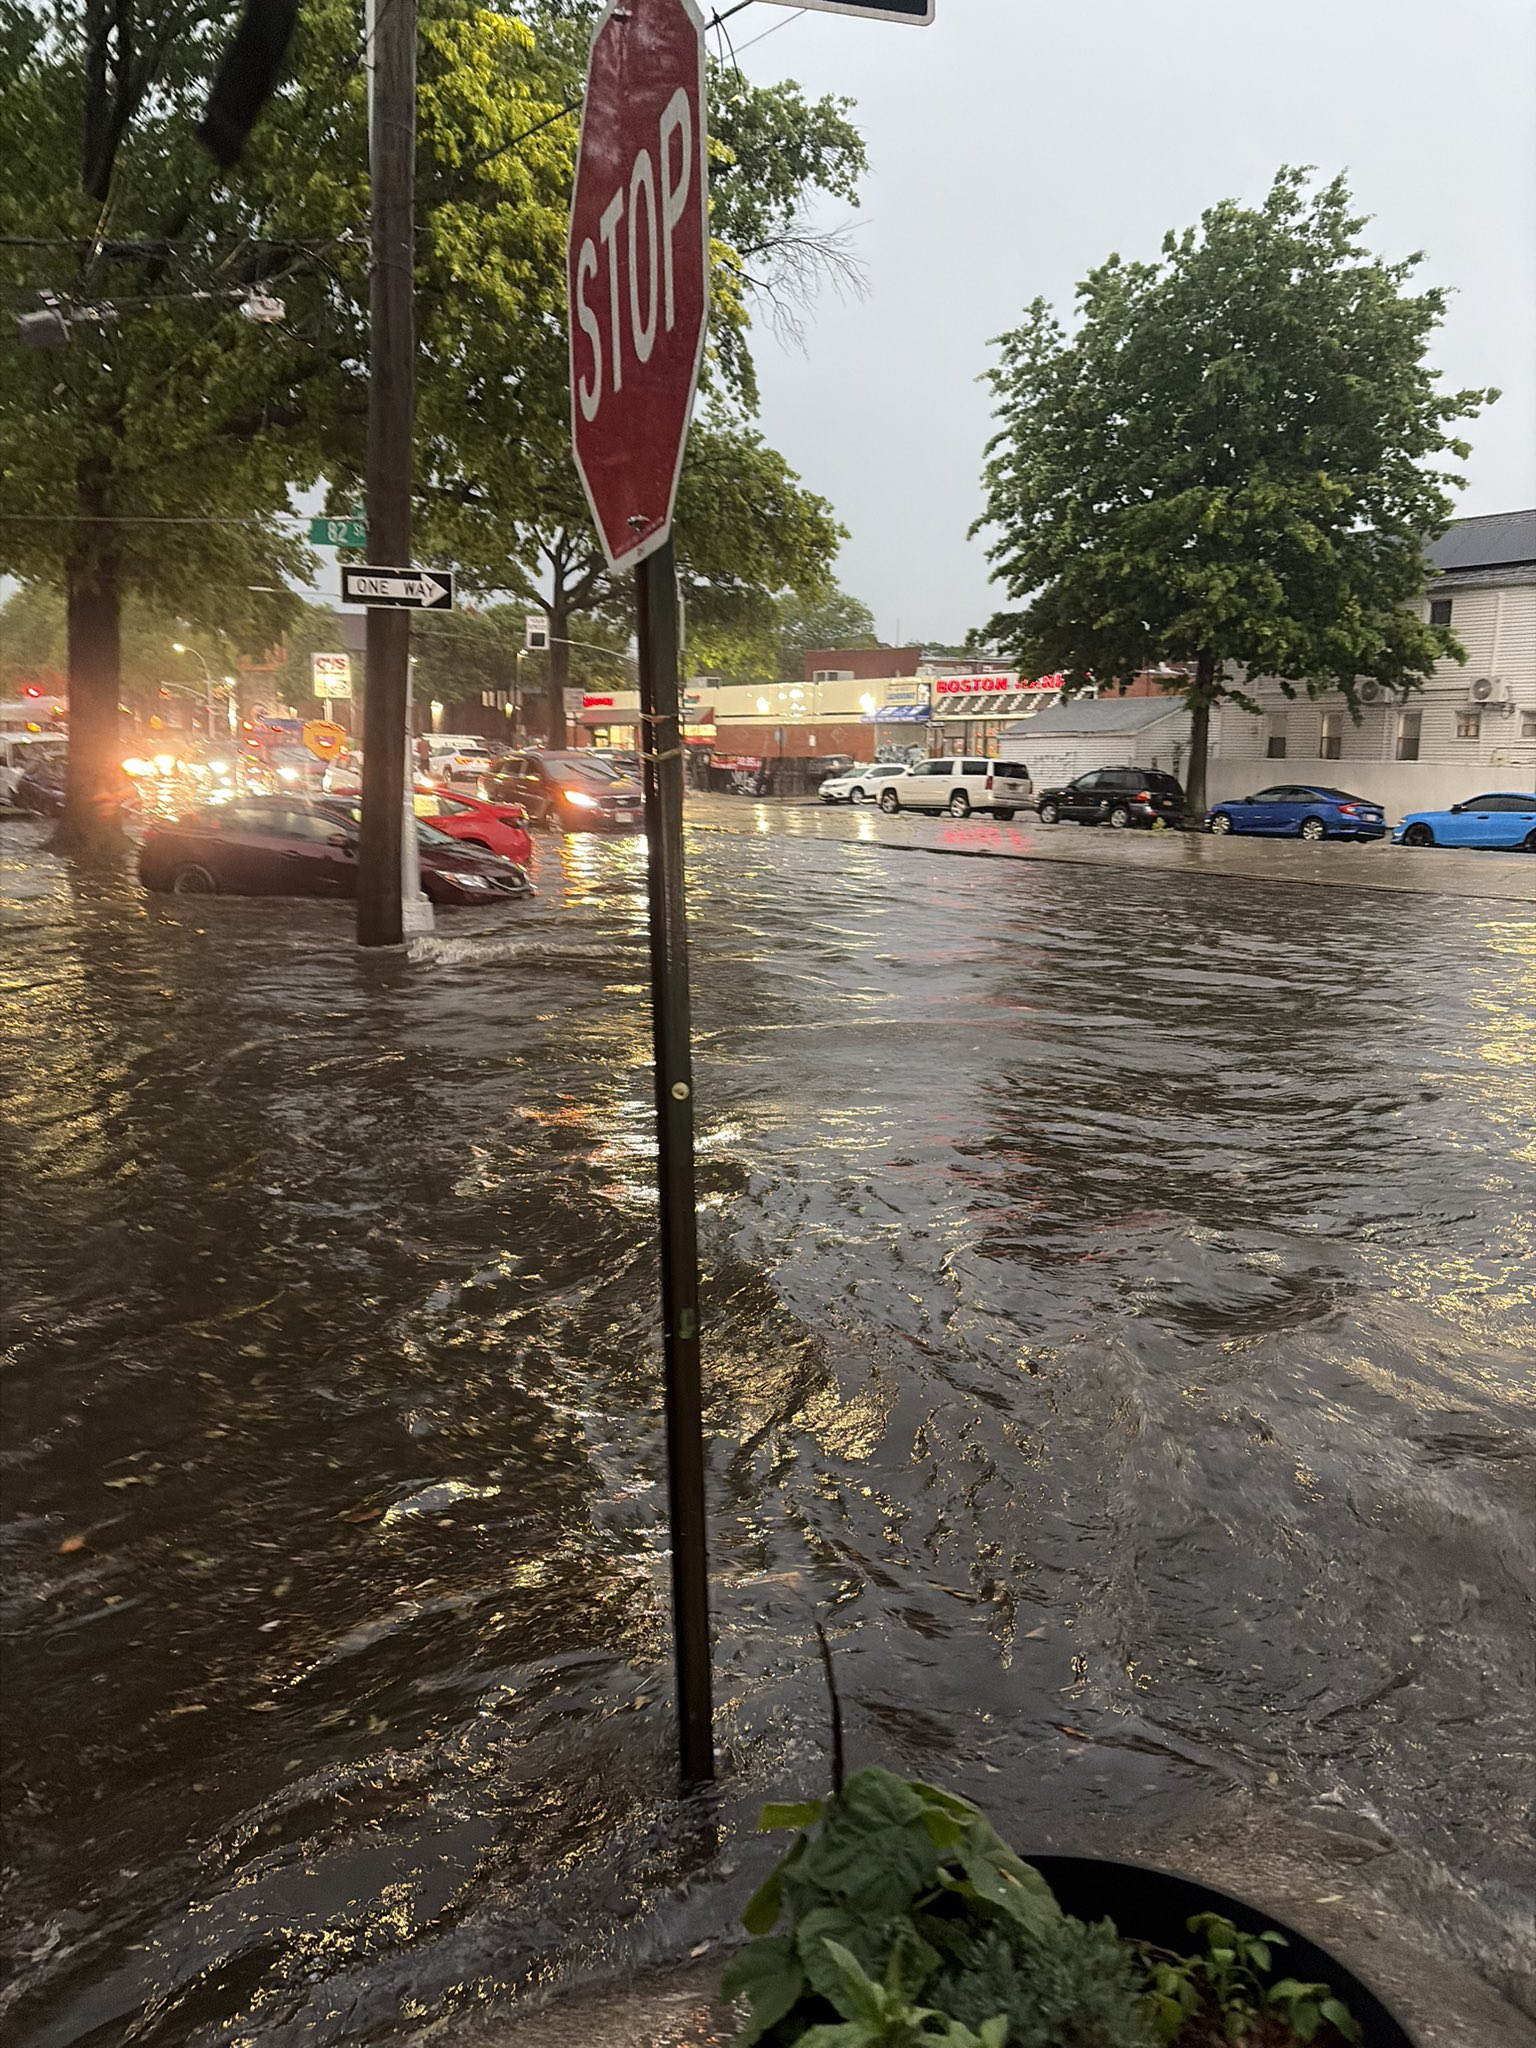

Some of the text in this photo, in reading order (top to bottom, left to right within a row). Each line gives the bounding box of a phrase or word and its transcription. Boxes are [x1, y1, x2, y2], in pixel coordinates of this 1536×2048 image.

[576, 86, 692, 423] STOP
[327, 521, 348, 544] 82
[356, 578, 435, 598] ONE WAY
[316, 657, 346, 671] CVS
[936, 677, 1008, 694] BOSTON
